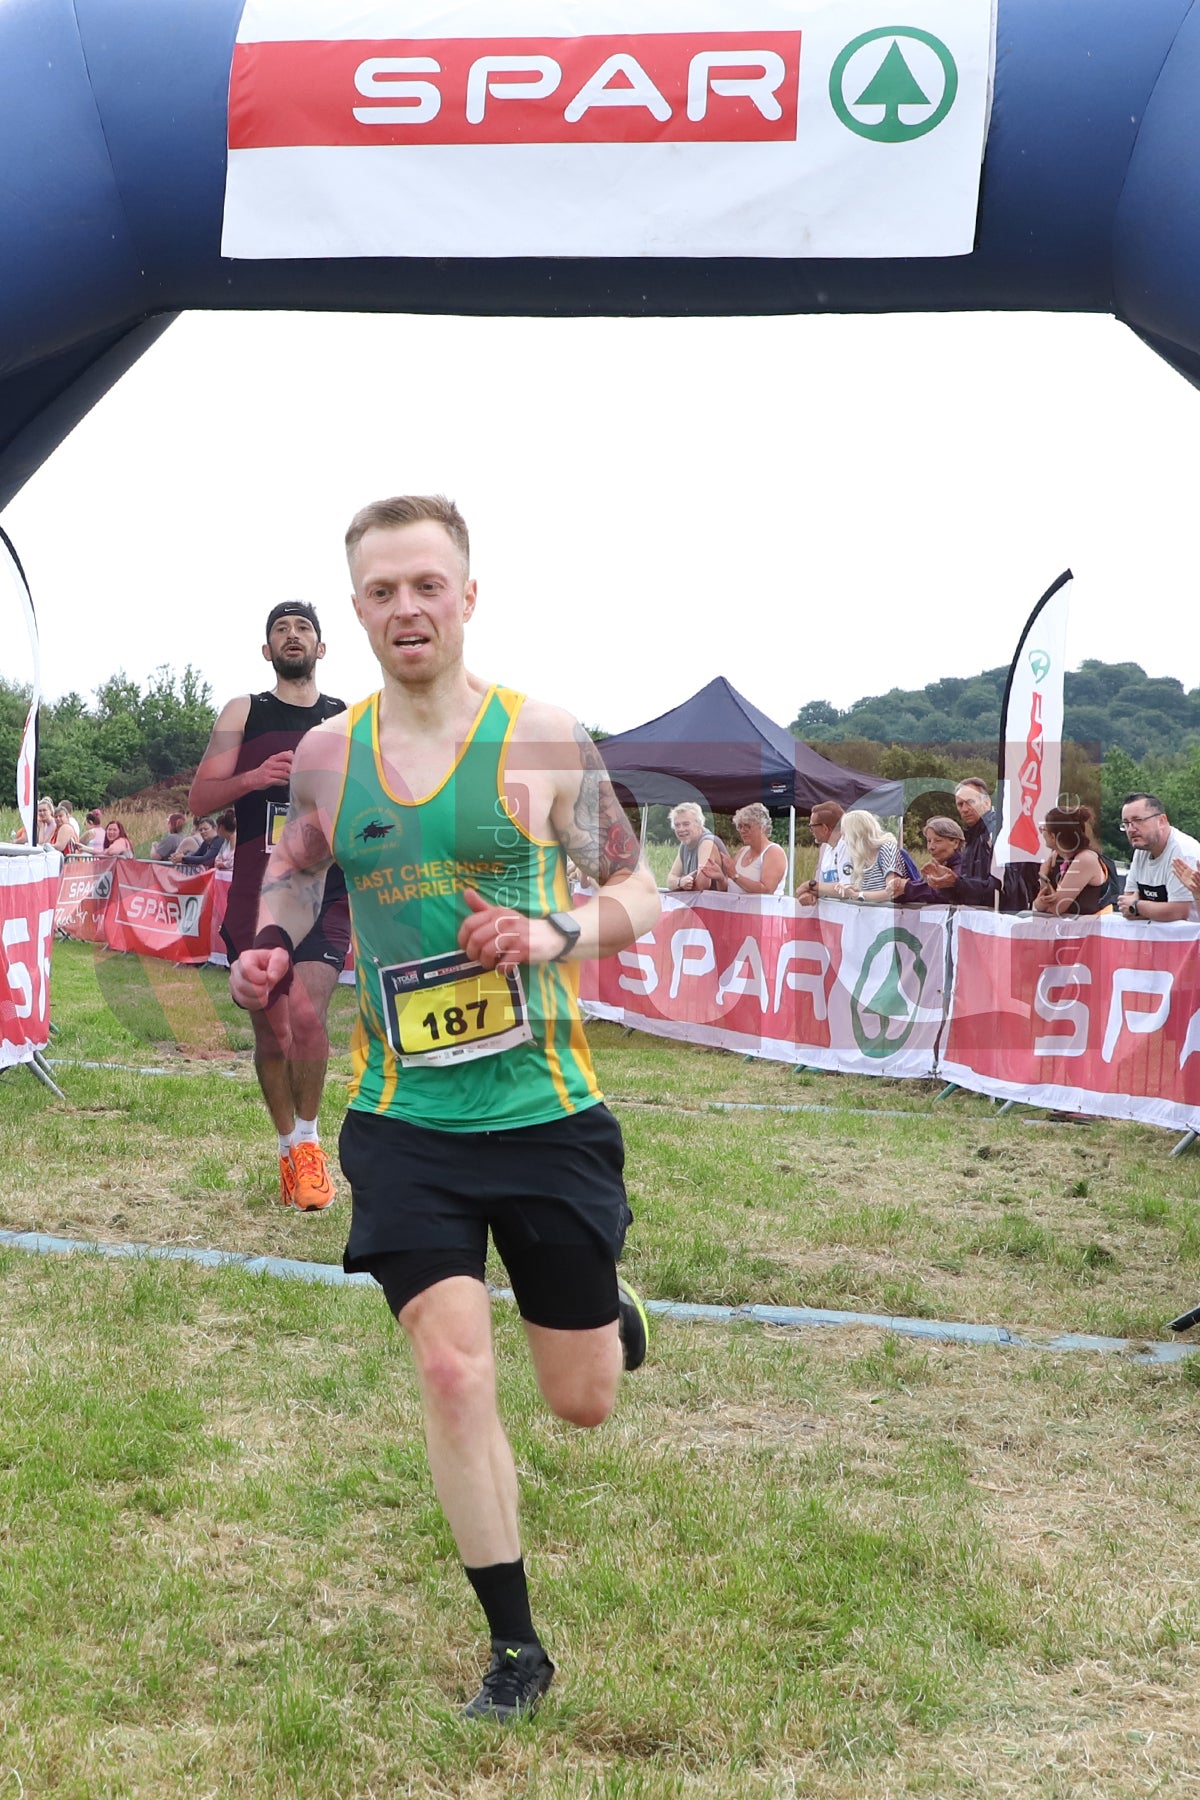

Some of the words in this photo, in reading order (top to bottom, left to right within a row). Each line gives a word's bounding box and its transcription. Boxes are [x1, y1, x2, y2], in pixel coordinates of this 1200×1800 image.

[353, 50, 786, 125] SPAR
[354, 868, 394, 891] EAST
[401, 861, 505, 881] CHESHIRE
[377, 877, 479, 905] HARRIERS
[126, 896, 182, 925] SPAR
[618, 928, 832, 1021] SPAR
[422, 1000, 488, 1040] 187
